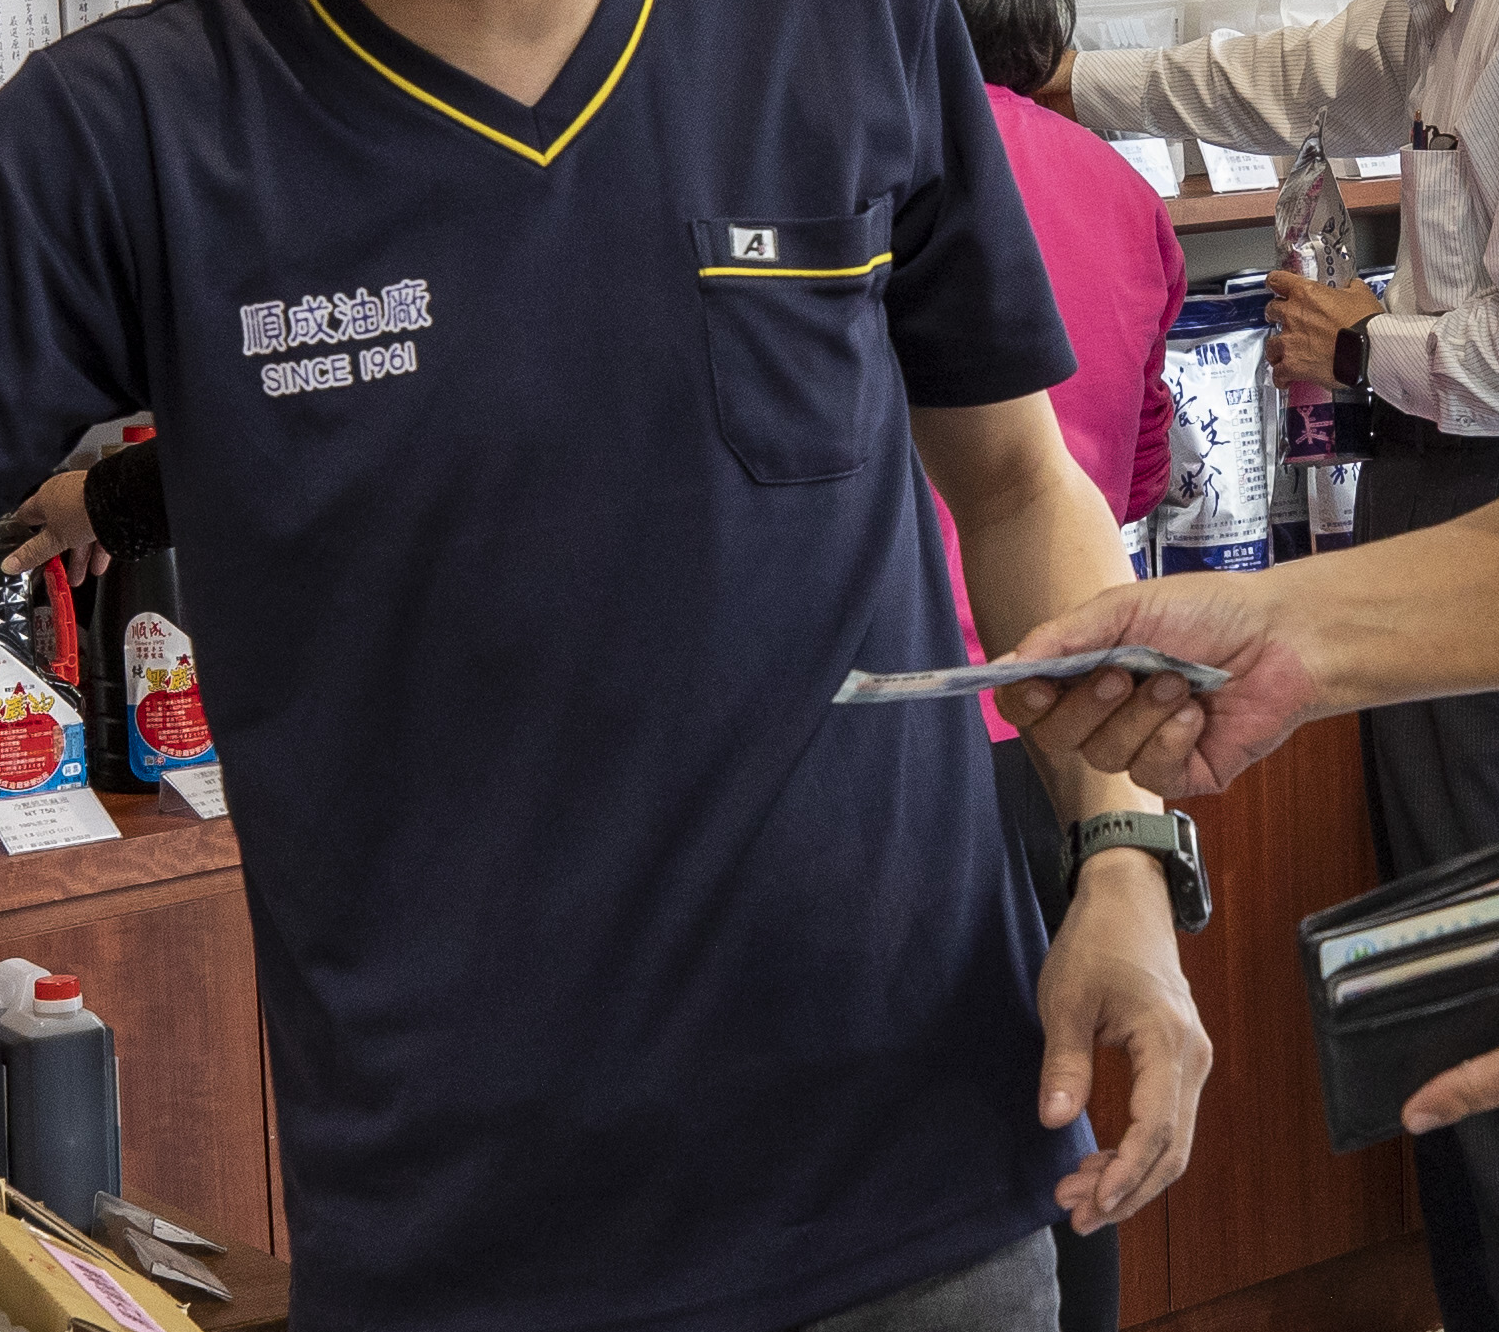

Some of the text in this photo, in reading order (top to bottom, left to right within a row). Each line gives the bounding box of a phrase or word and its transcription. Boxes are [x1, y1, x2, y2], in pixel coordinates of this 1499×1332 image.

[241, 279, 432, 355] 順成油廠
[261, 341, 417, 396] SINCE 1961
[132, 621, 166, 639] 順成
[145, 666, 198, 694] 黑麻
